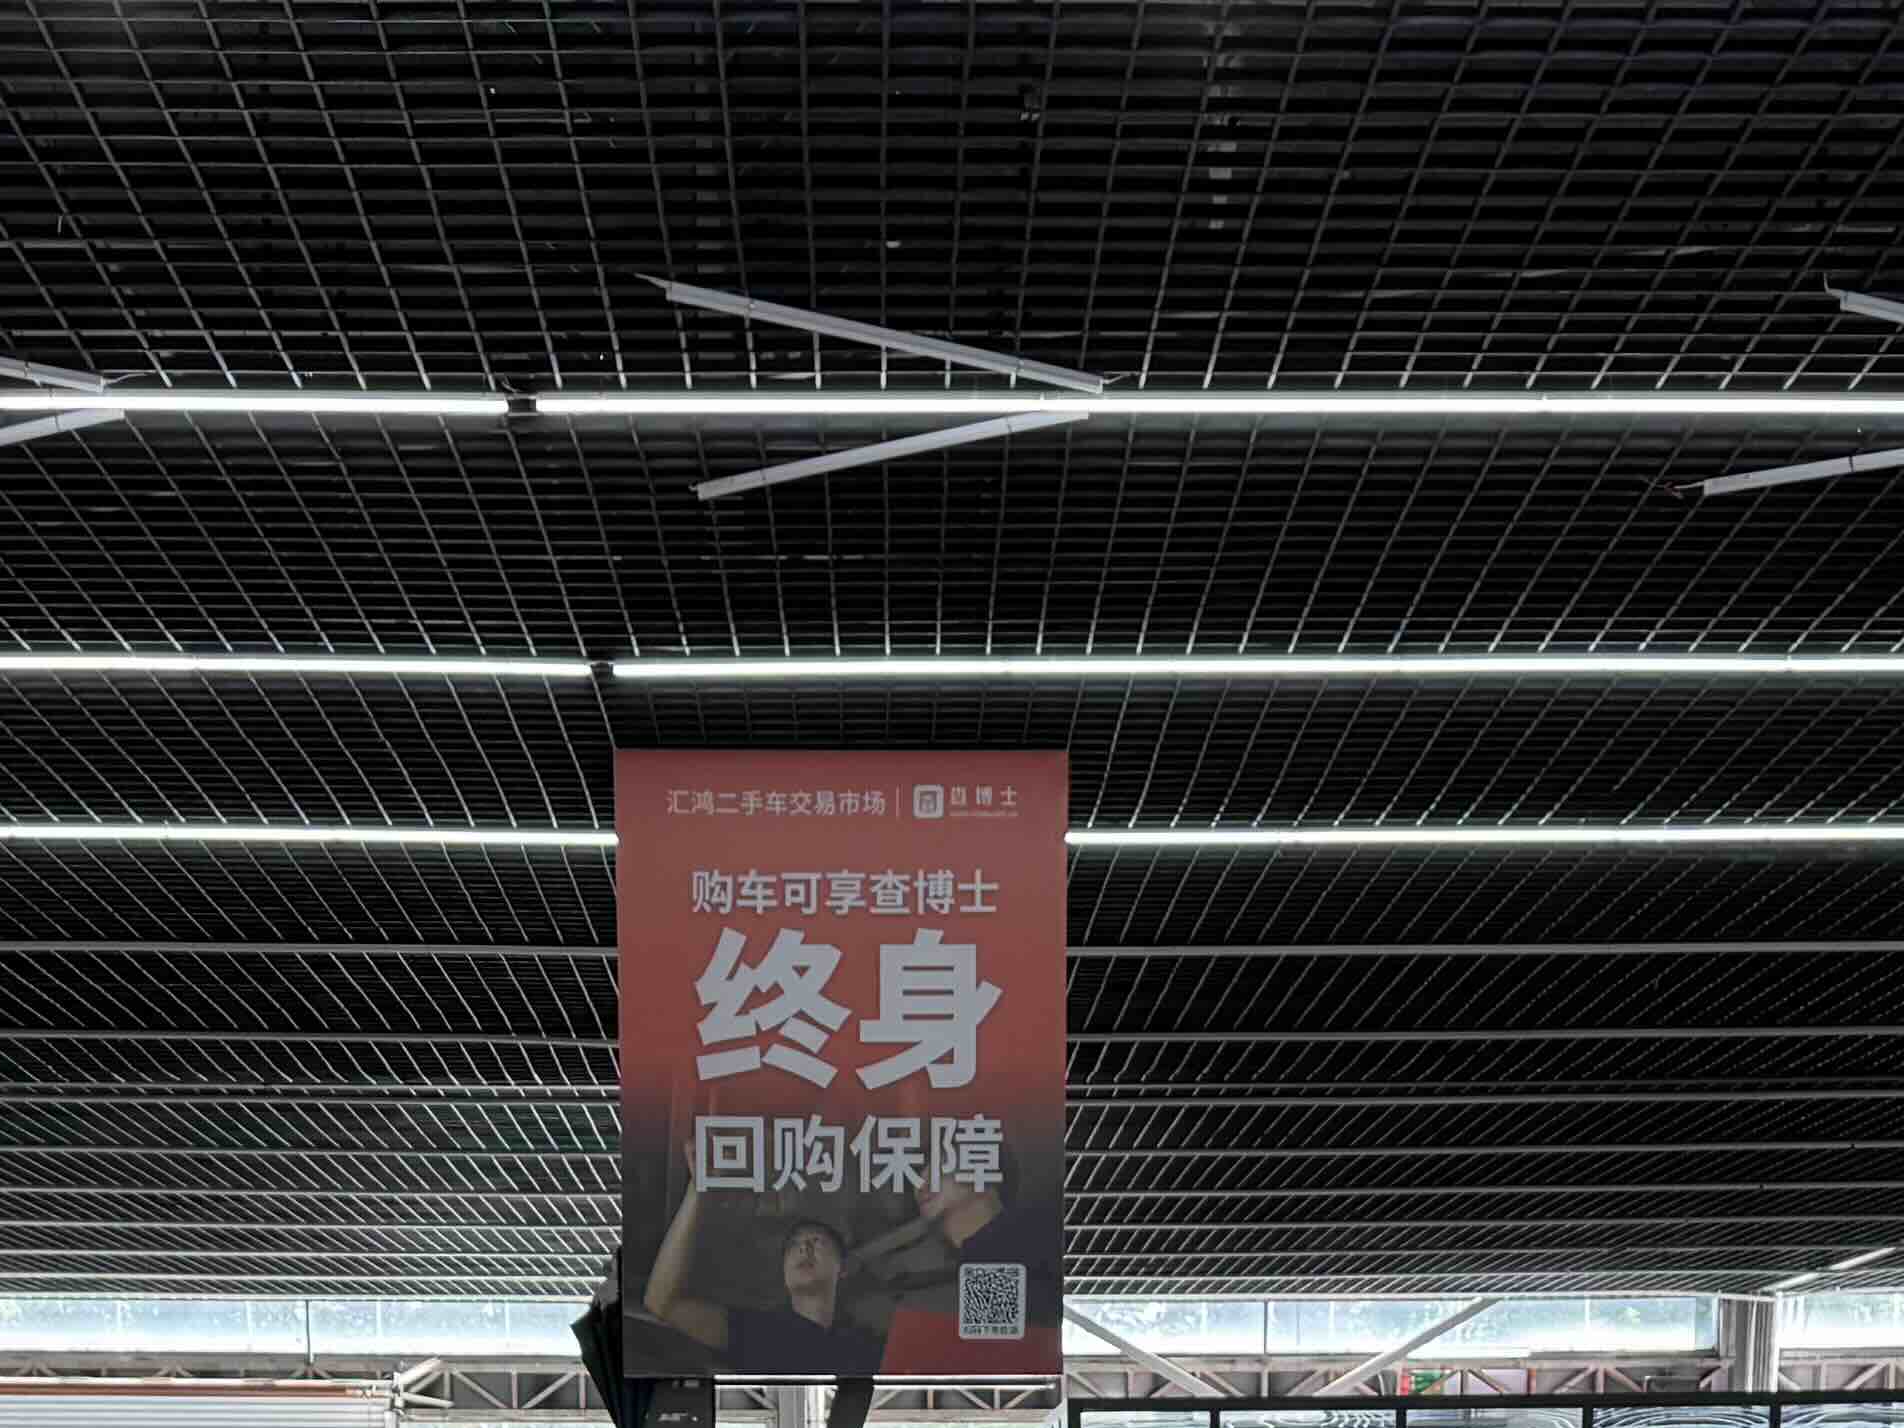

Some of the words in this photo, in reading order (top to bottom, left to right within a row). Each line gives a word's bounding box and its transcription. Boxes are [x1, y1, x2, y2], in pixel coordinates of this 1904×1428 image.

[667, 789, 886, 816] 汇鸿二手车交易市场
[691, 870, 999, 915] 购车可享查博士
[695, 927, 1003, 1089] 终身
[695, 1114, 1004, 1193] 回购保障
